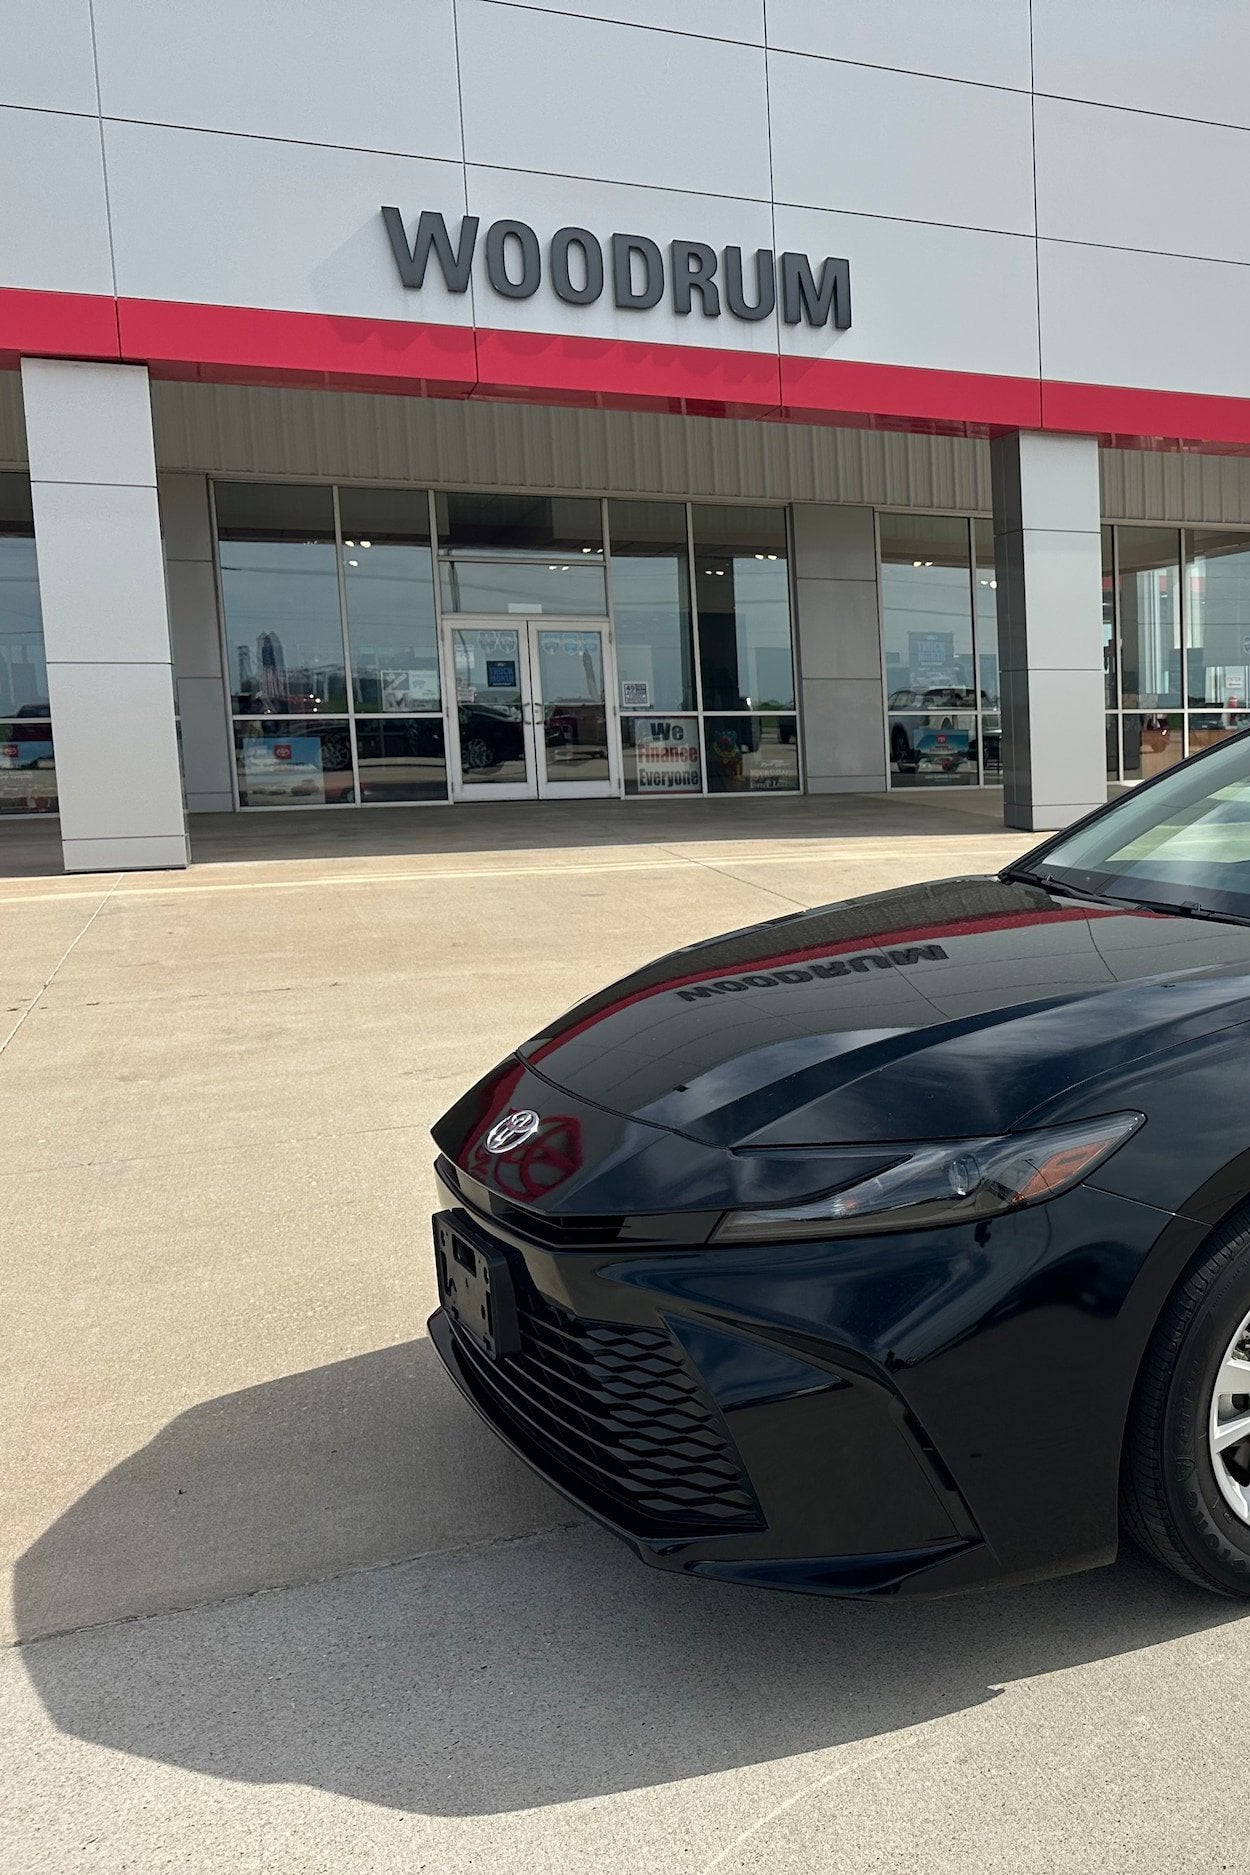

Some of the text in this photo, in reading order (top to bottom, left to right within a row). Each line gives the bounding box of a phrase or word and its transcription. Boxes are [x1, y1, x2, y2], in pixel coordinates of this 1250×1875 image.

[381, 206, 852, 329] WOODRUM
[650, 723, 684, 741] We
[637, 744, 698, 764] Finance
[638, 769, 699, 788] Everyone
